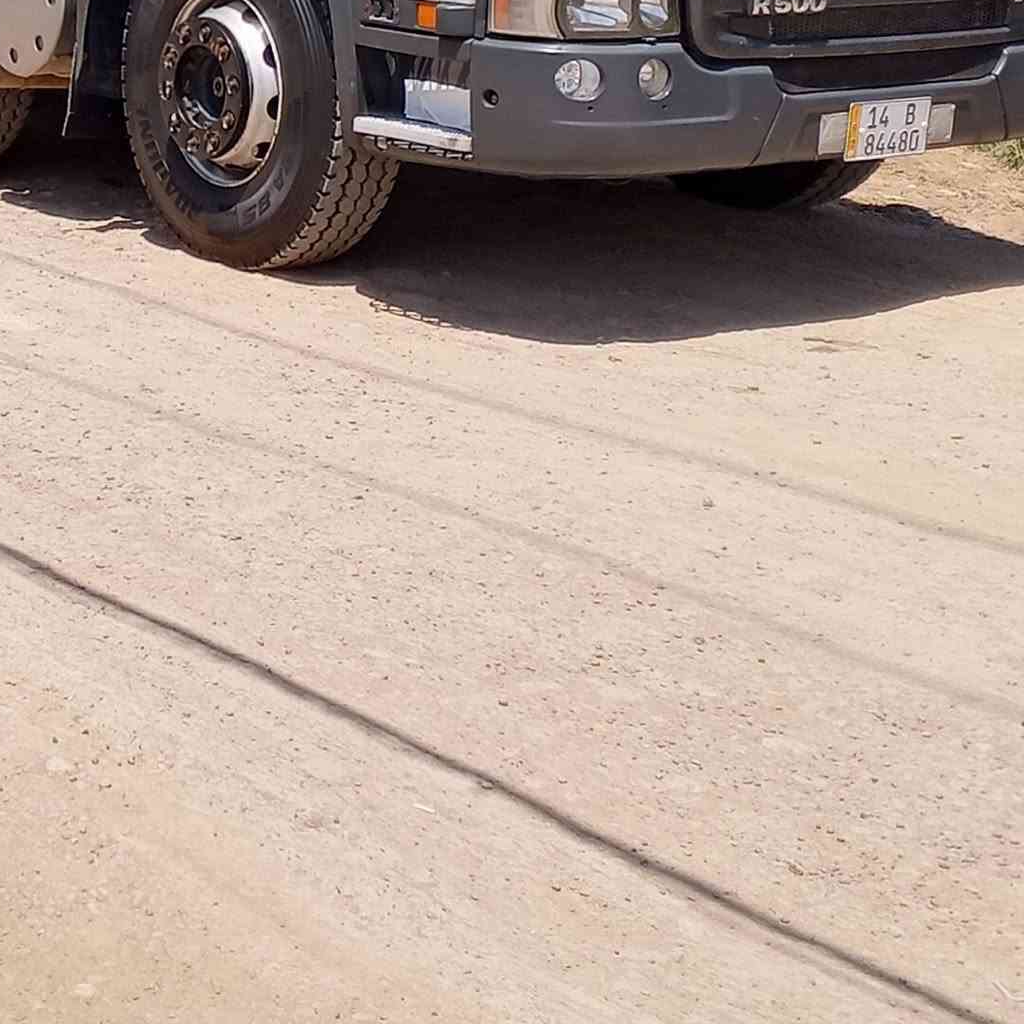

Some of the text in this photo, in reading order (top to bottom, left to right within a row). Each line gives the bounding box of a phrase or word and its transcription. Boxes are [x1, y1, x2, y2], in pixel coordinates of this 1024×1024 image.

[867, 103, 917, 129] 14 B
[864, 129, 919, 156] 84480
